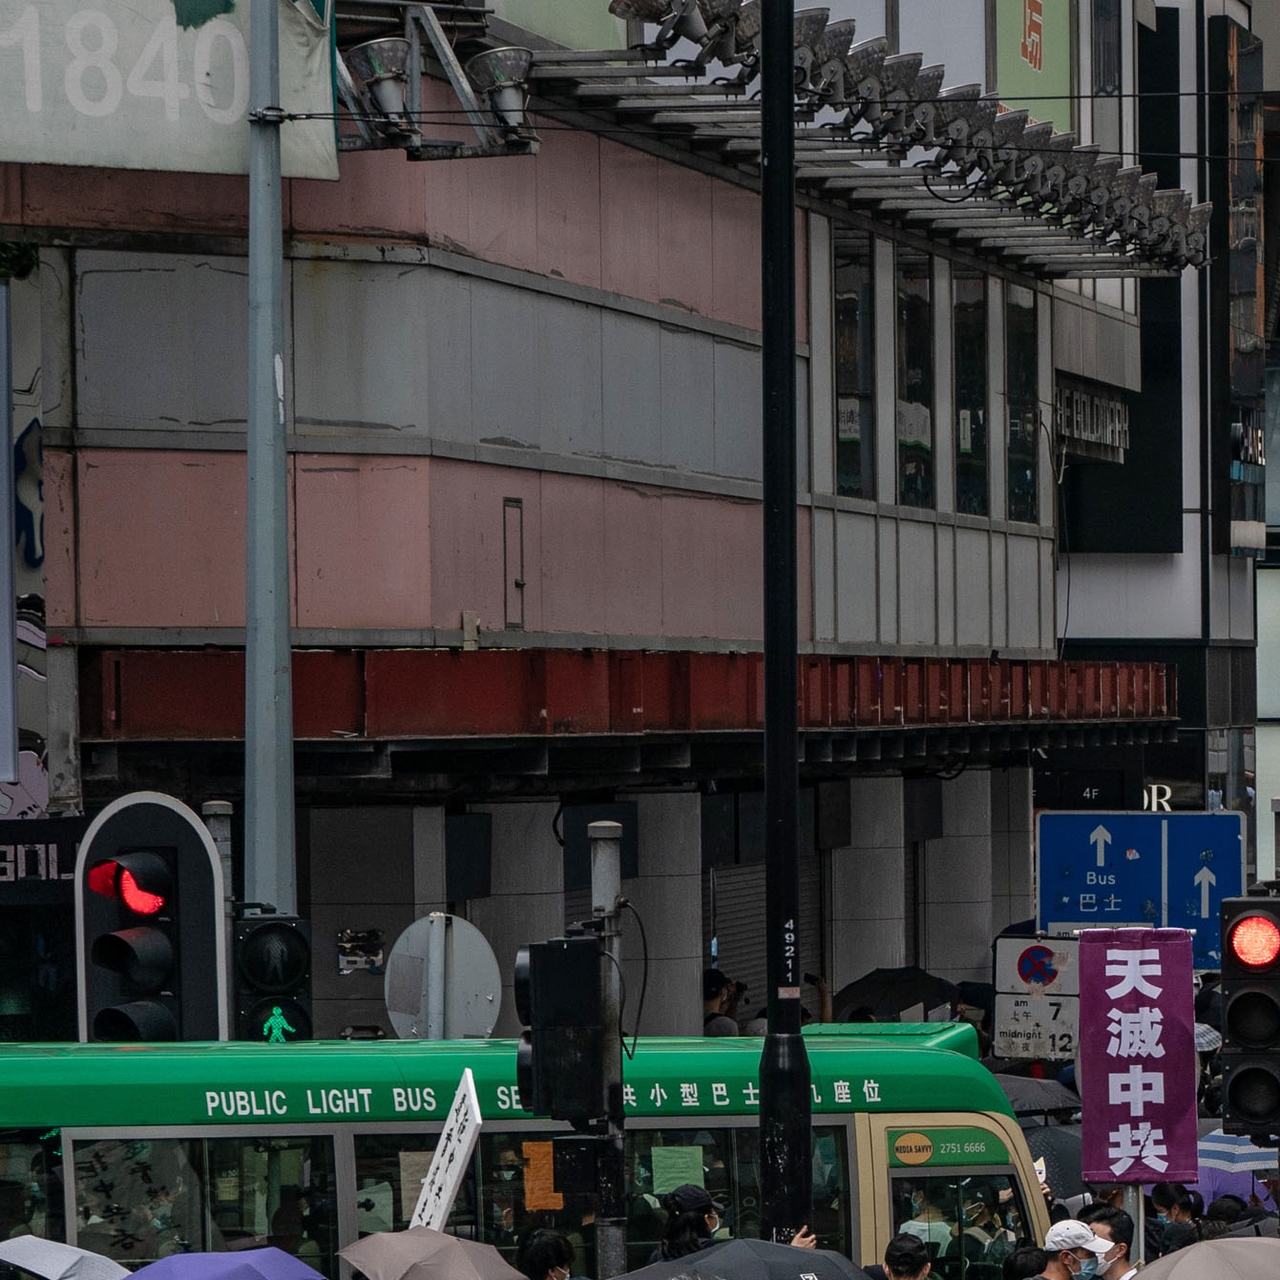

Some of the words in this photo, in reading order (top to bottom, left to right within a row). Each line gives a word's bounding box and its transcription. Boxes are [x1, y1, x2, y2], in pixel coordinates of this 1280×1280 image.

[1143, 784, 1172, 812] R
[1086, 871, 1116, 885] Bus
[1079, 893, 1122, 912] 巴士
[784, 919, 795, 983] 49211
[1014, 999, 1028, 1007] am
[1048, 1003, 1061, 1021] 7
[999, 1029, 1042, 1041] midnight
[1048, 1034, 1071, 1053] 12
[1104, 948, 1169, 1176] 天滅中共
[206, 1088, 288, 1117] PUBLIC
[307, 1087, 373, 1115] LIGHT
[393, 1087, 437, 1114] BUS
[940, 1143, 961, 1154] 2751
[964, 1142, 986, 1153] 6666
